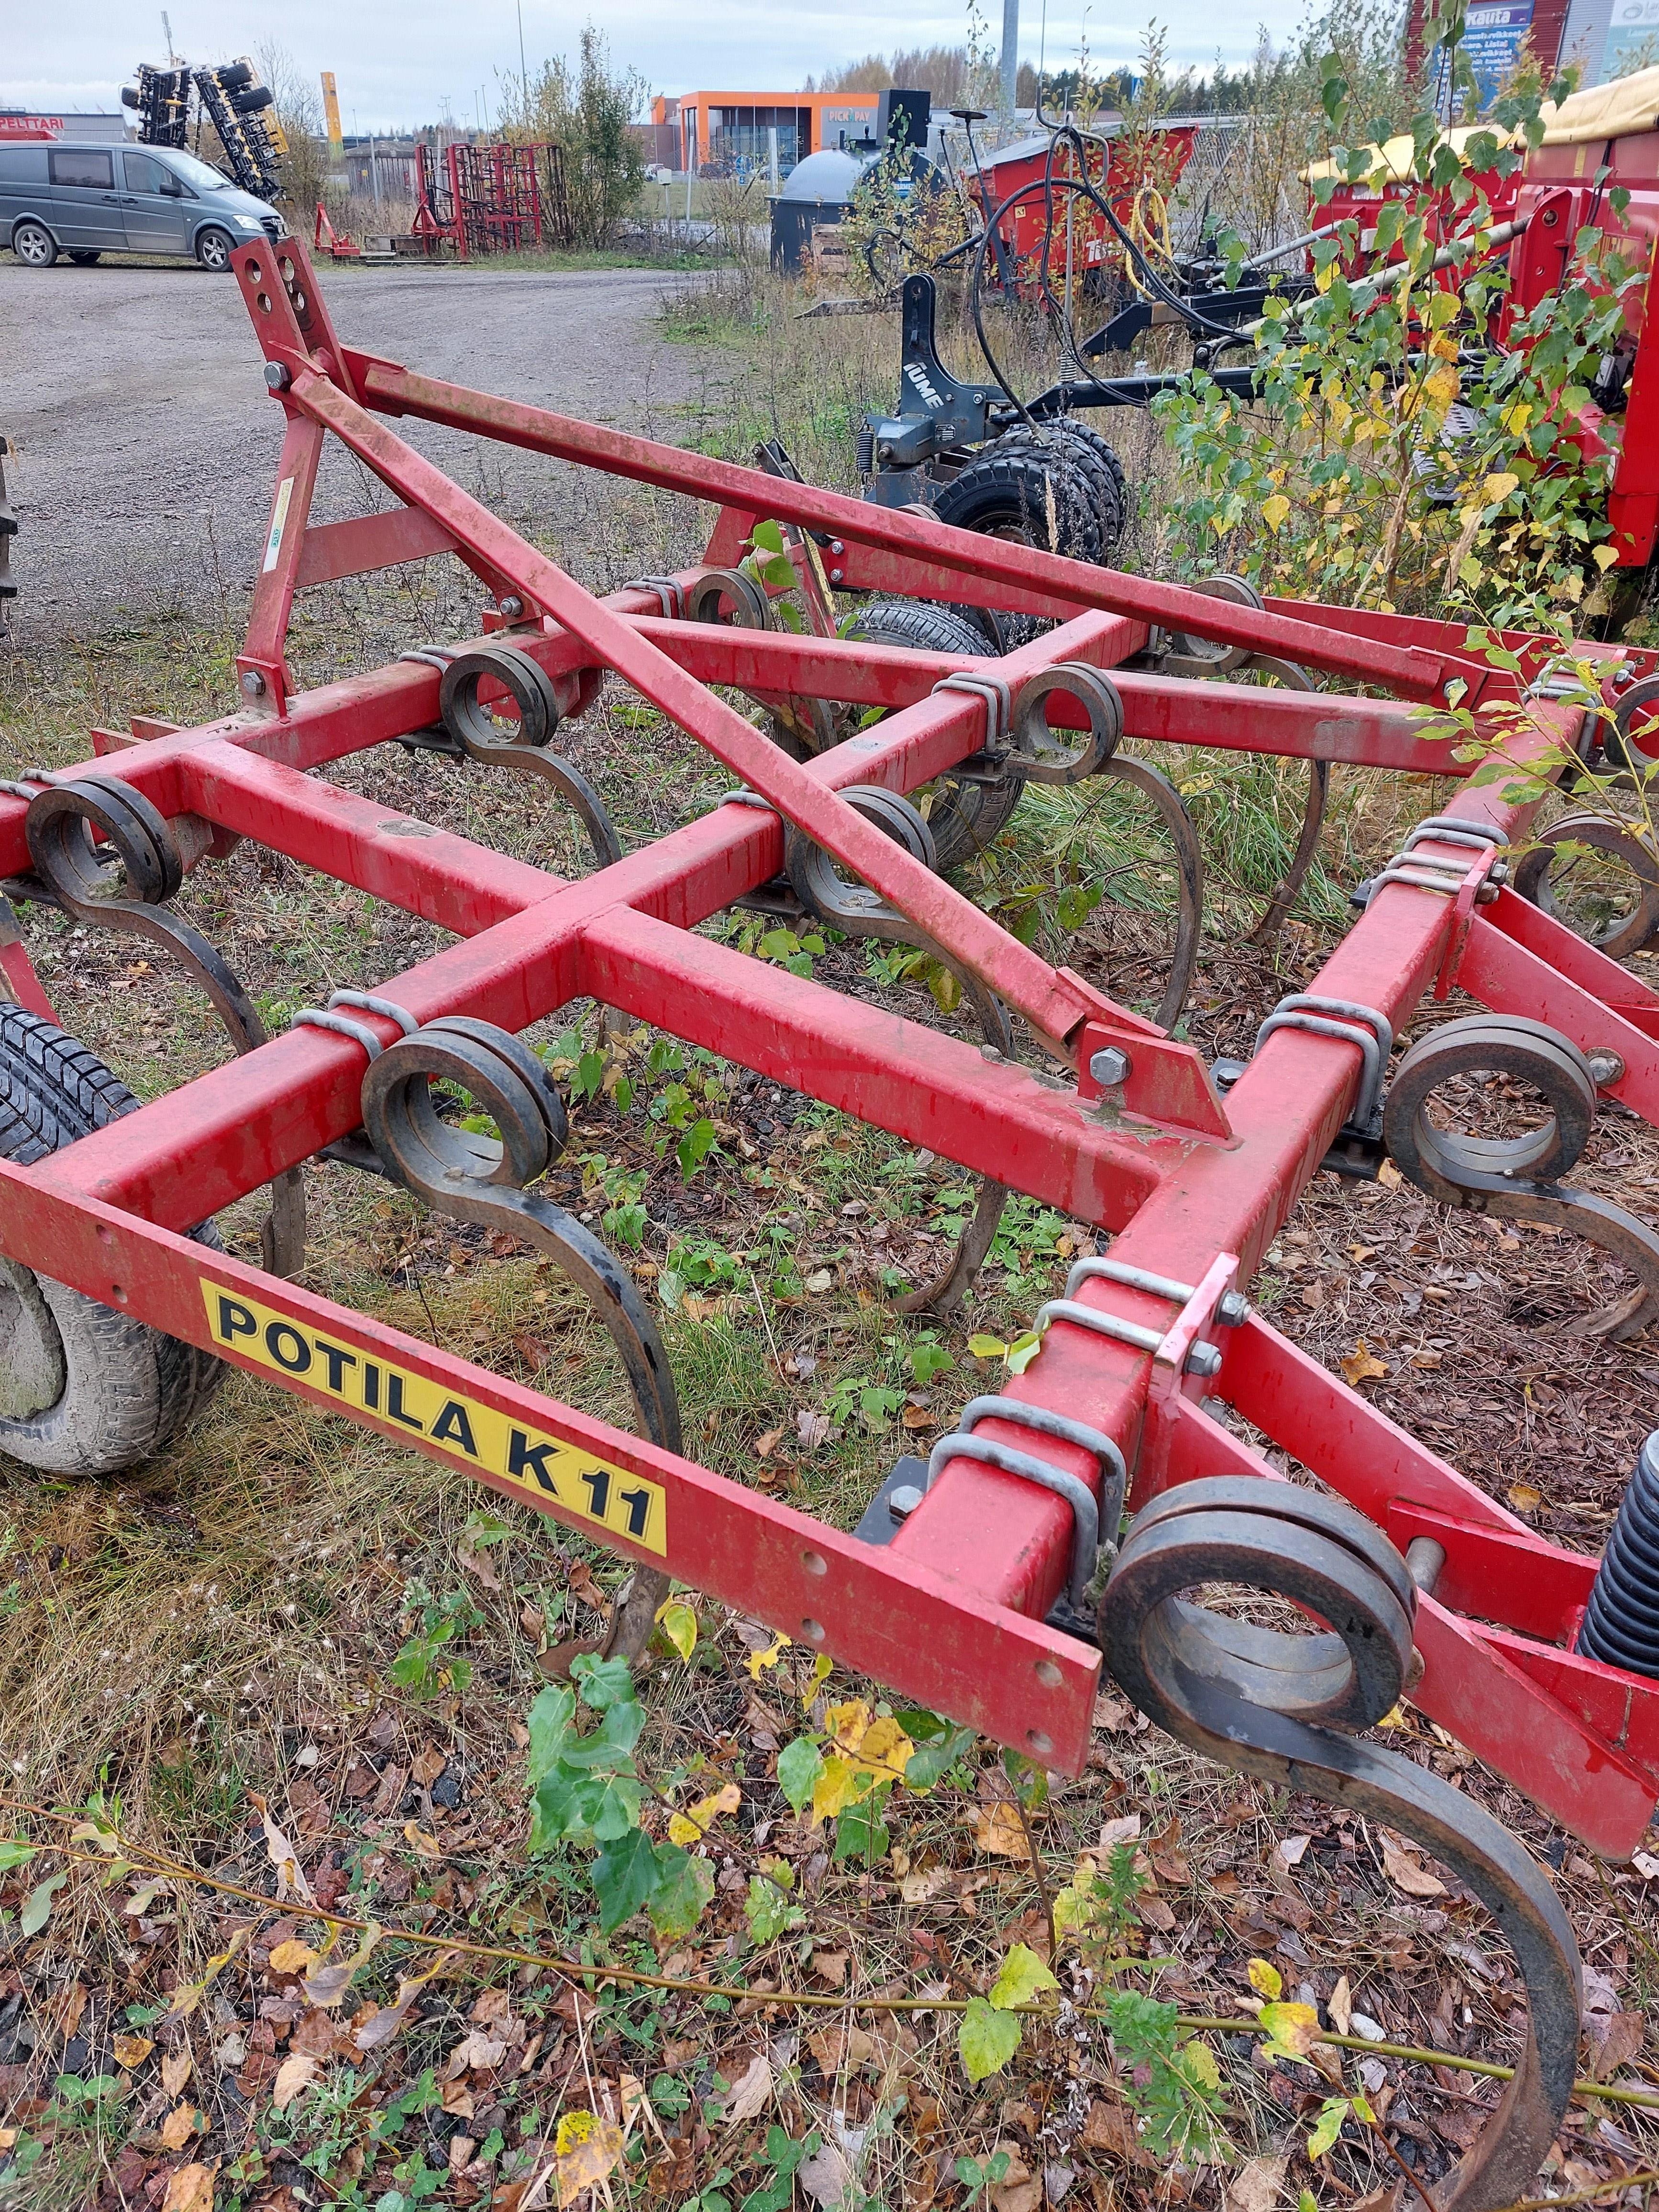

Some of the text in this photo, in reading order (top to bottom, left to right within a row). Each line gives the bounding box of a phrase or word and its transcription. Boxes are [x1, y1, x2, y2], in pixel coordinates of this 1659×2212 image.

[903, 362, 945, 409] TUME
[218, 1295, 650, 1537] POTILA K 11
